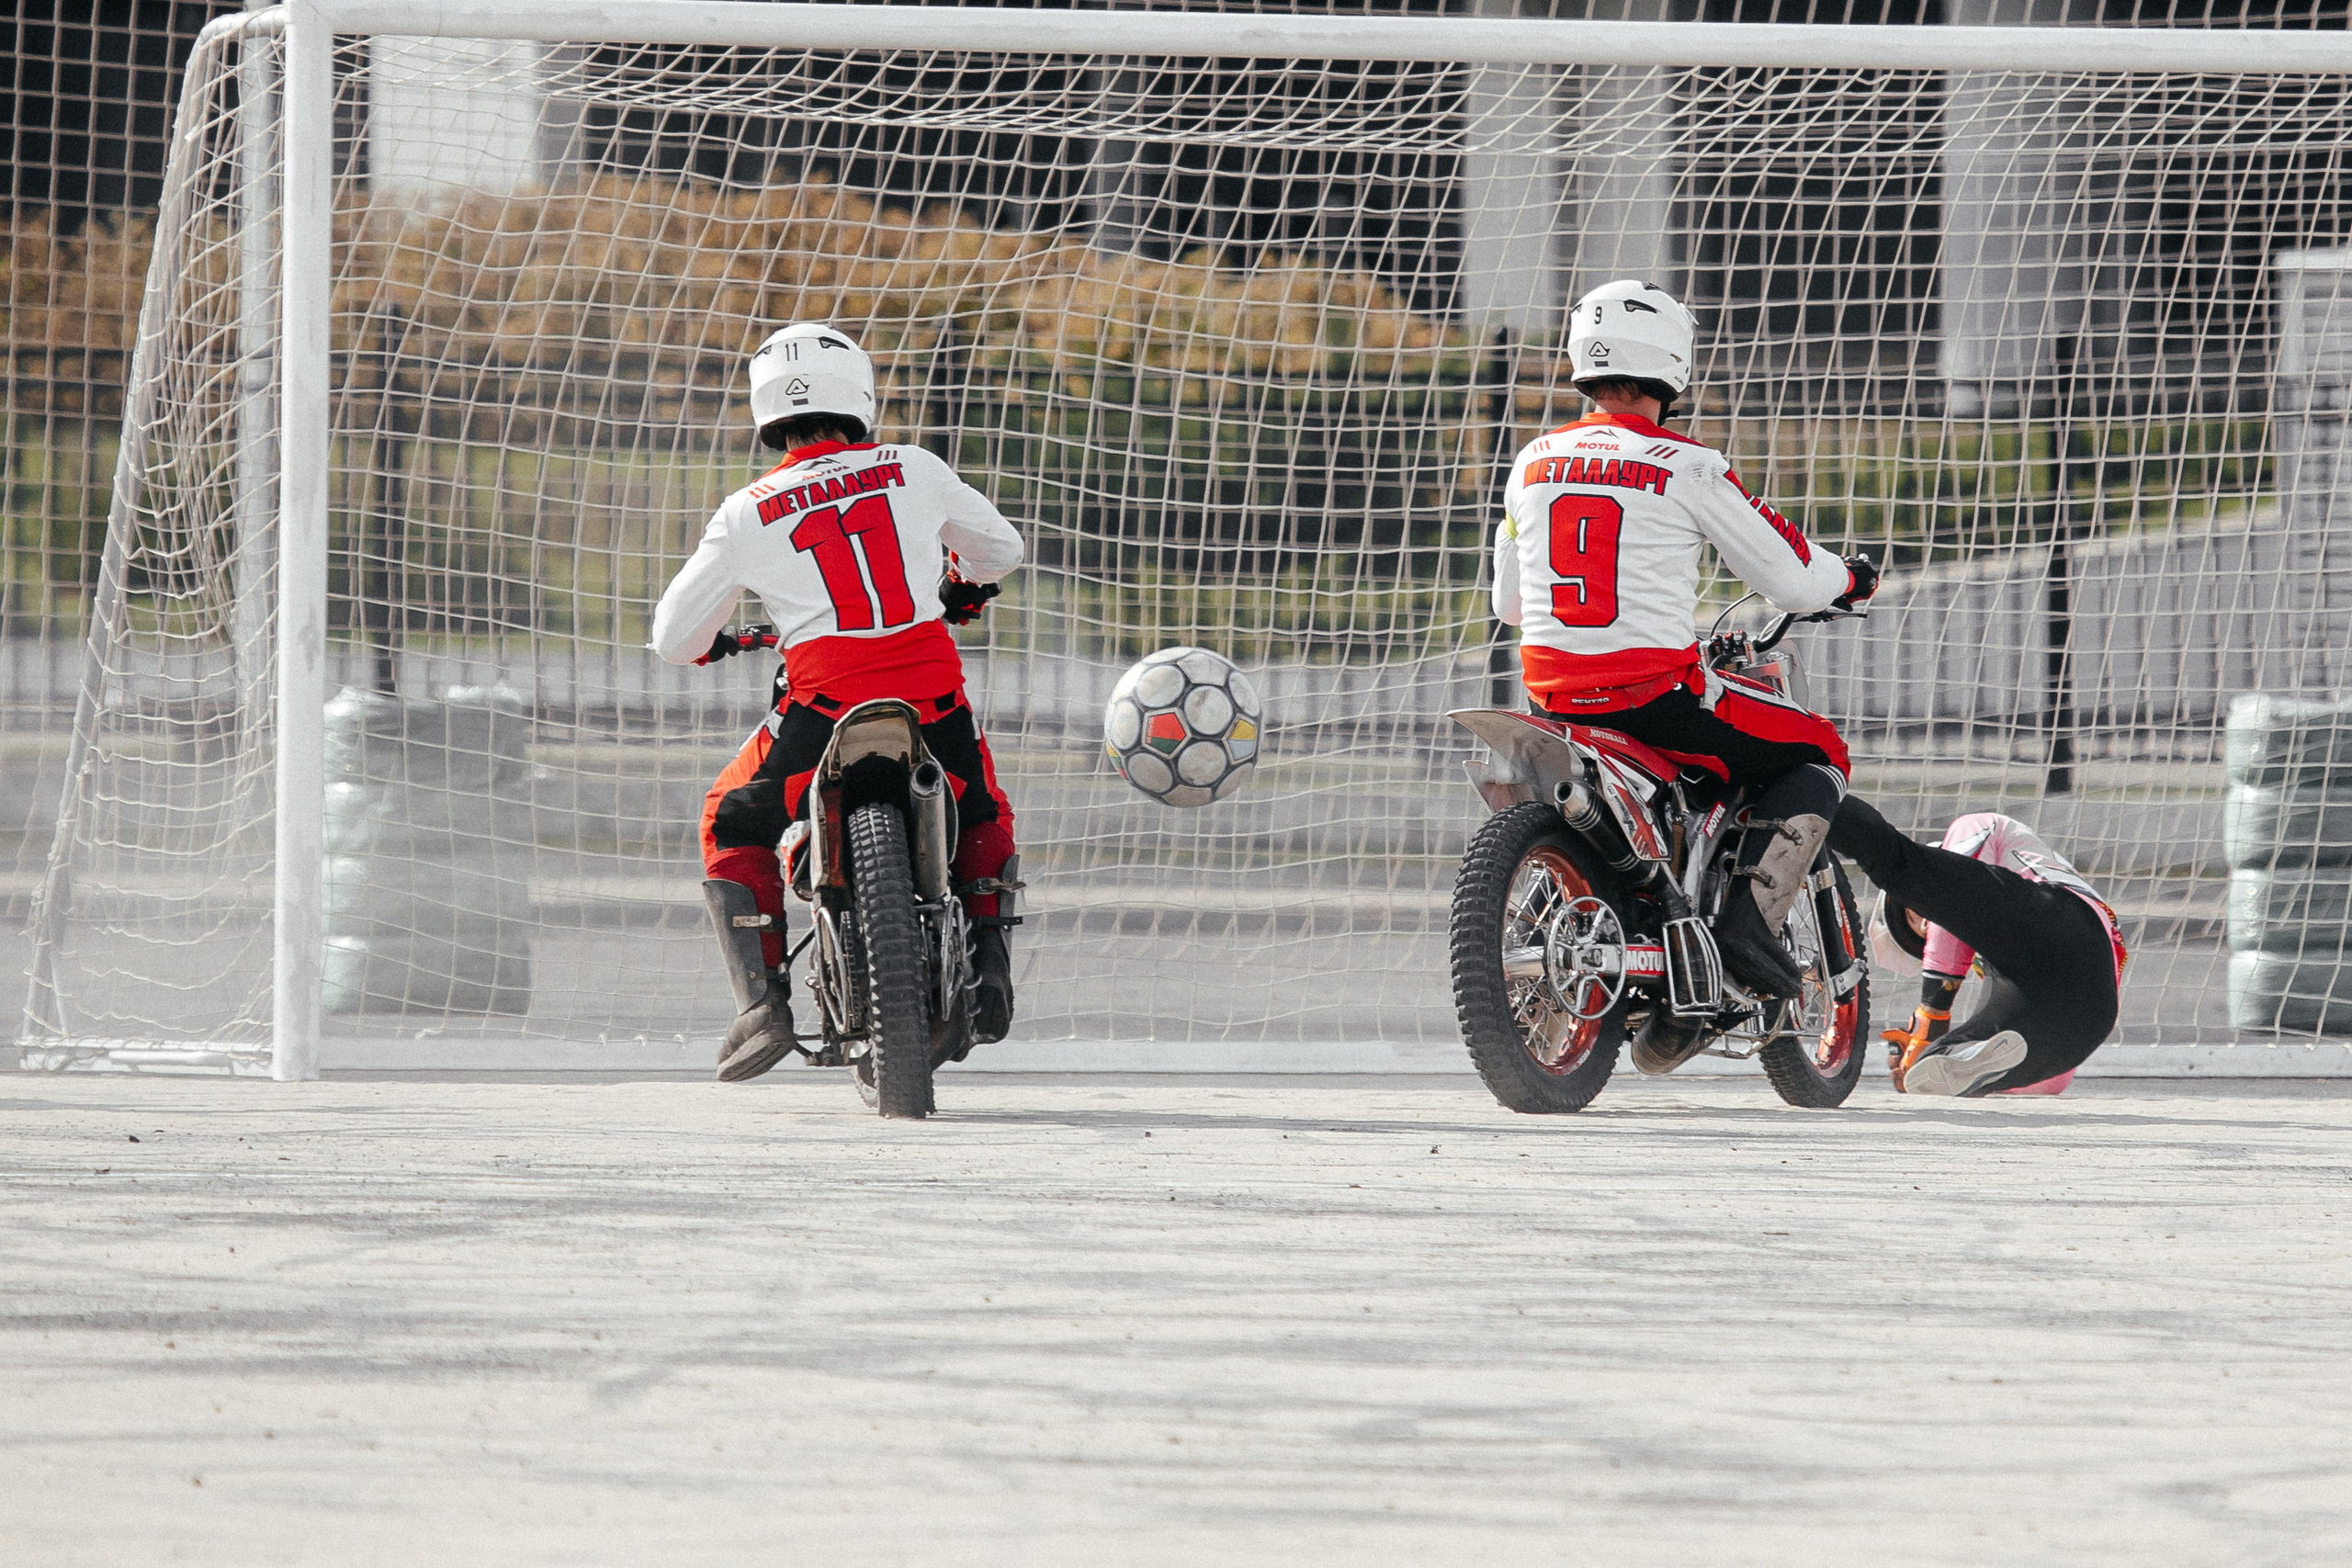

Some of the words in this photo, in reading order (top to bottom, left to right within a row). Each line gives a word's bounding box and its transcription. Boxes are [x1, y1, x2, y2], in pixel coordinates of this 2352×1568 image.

[1594, 305, 1602, 324] 9
[785, 342, 797, 361] 11
[1575, 441, 1621, 451] MOTUL
[1522, 457, 1673, 496] МЕТАЛЛУРГ
[757, 463, 906, 527] МЕТАЛЛУРГ
[788, 492, 915, 632] 11
[1549, 492, 1624, 628] 9
[1704, 803, 1726, 839] MOTUL
[1626, 950, 1665, 972] MOTU
